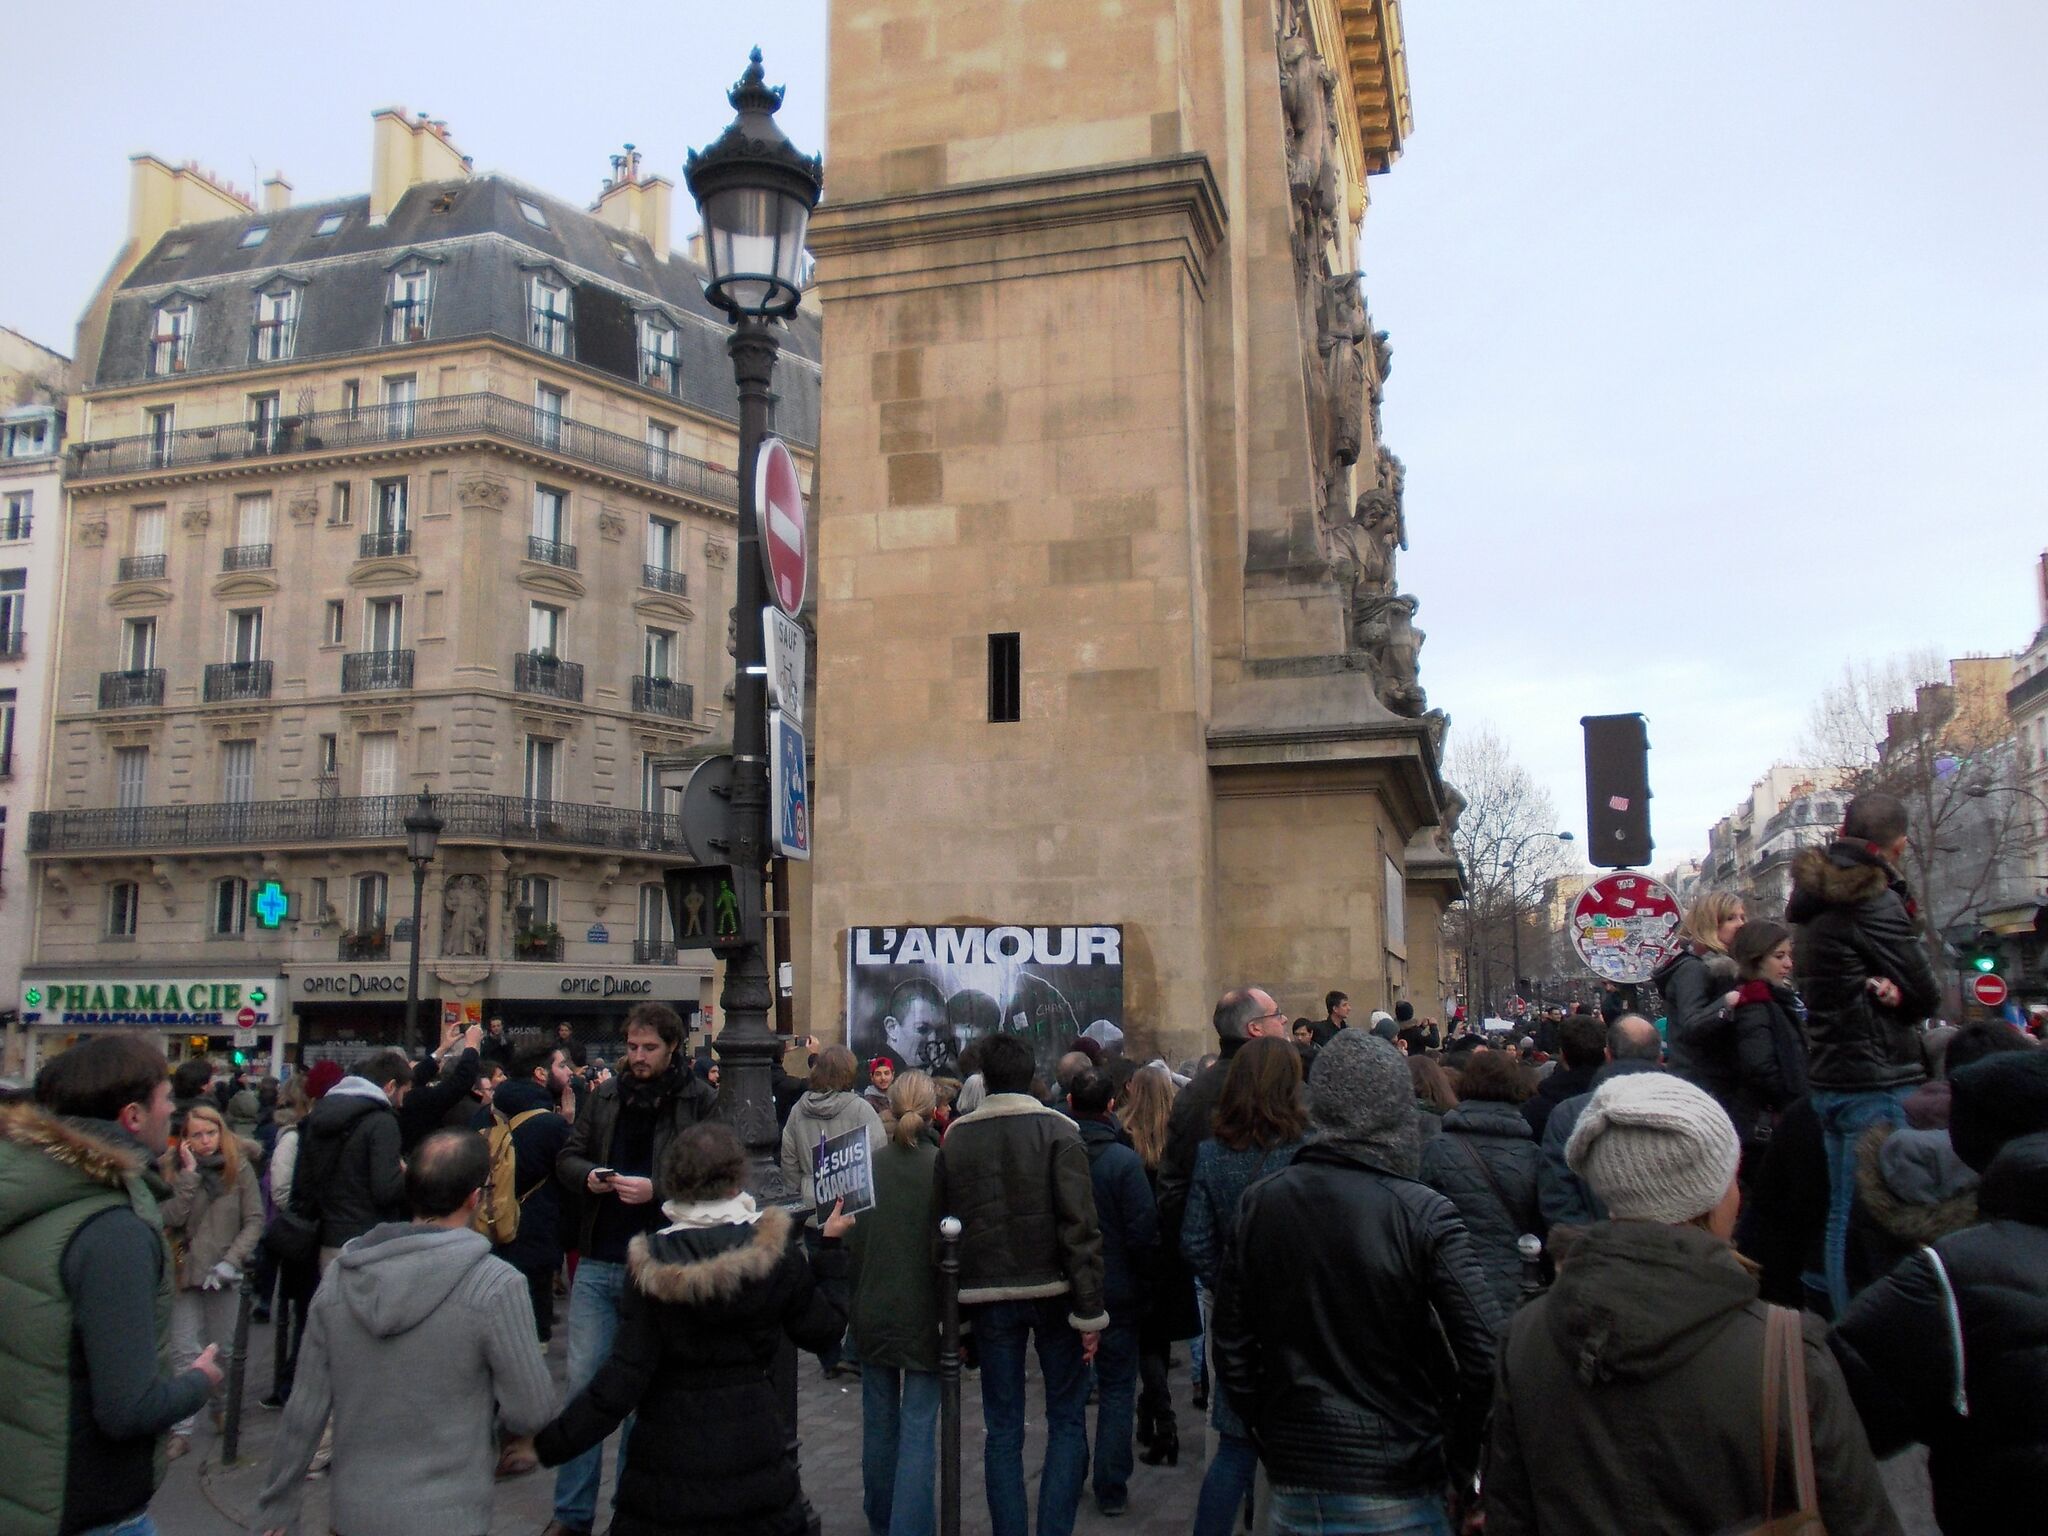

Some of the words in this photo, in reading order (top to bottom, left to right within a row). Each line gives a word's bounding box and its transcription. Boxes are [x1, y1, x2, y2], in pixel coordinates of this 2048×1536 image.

[779, 621, 797, 652] SAUF
[856, 926, 1121, 965] L'AMOUR
[46, 984, 242, 1011] PHARMACIE
[304, 977, 347, 993] OPTIC
[350, 973, 406, 997] DUROC
[561, 978, 600, 993] OPTIC
[604, 975, 651, 997] DUROC
[63, 1013, 223, 1024] PARAPHARMACIE
[831, 1143, 864, 1170] SUIS
[816, 1163, 867, 1204] CHARLIE
